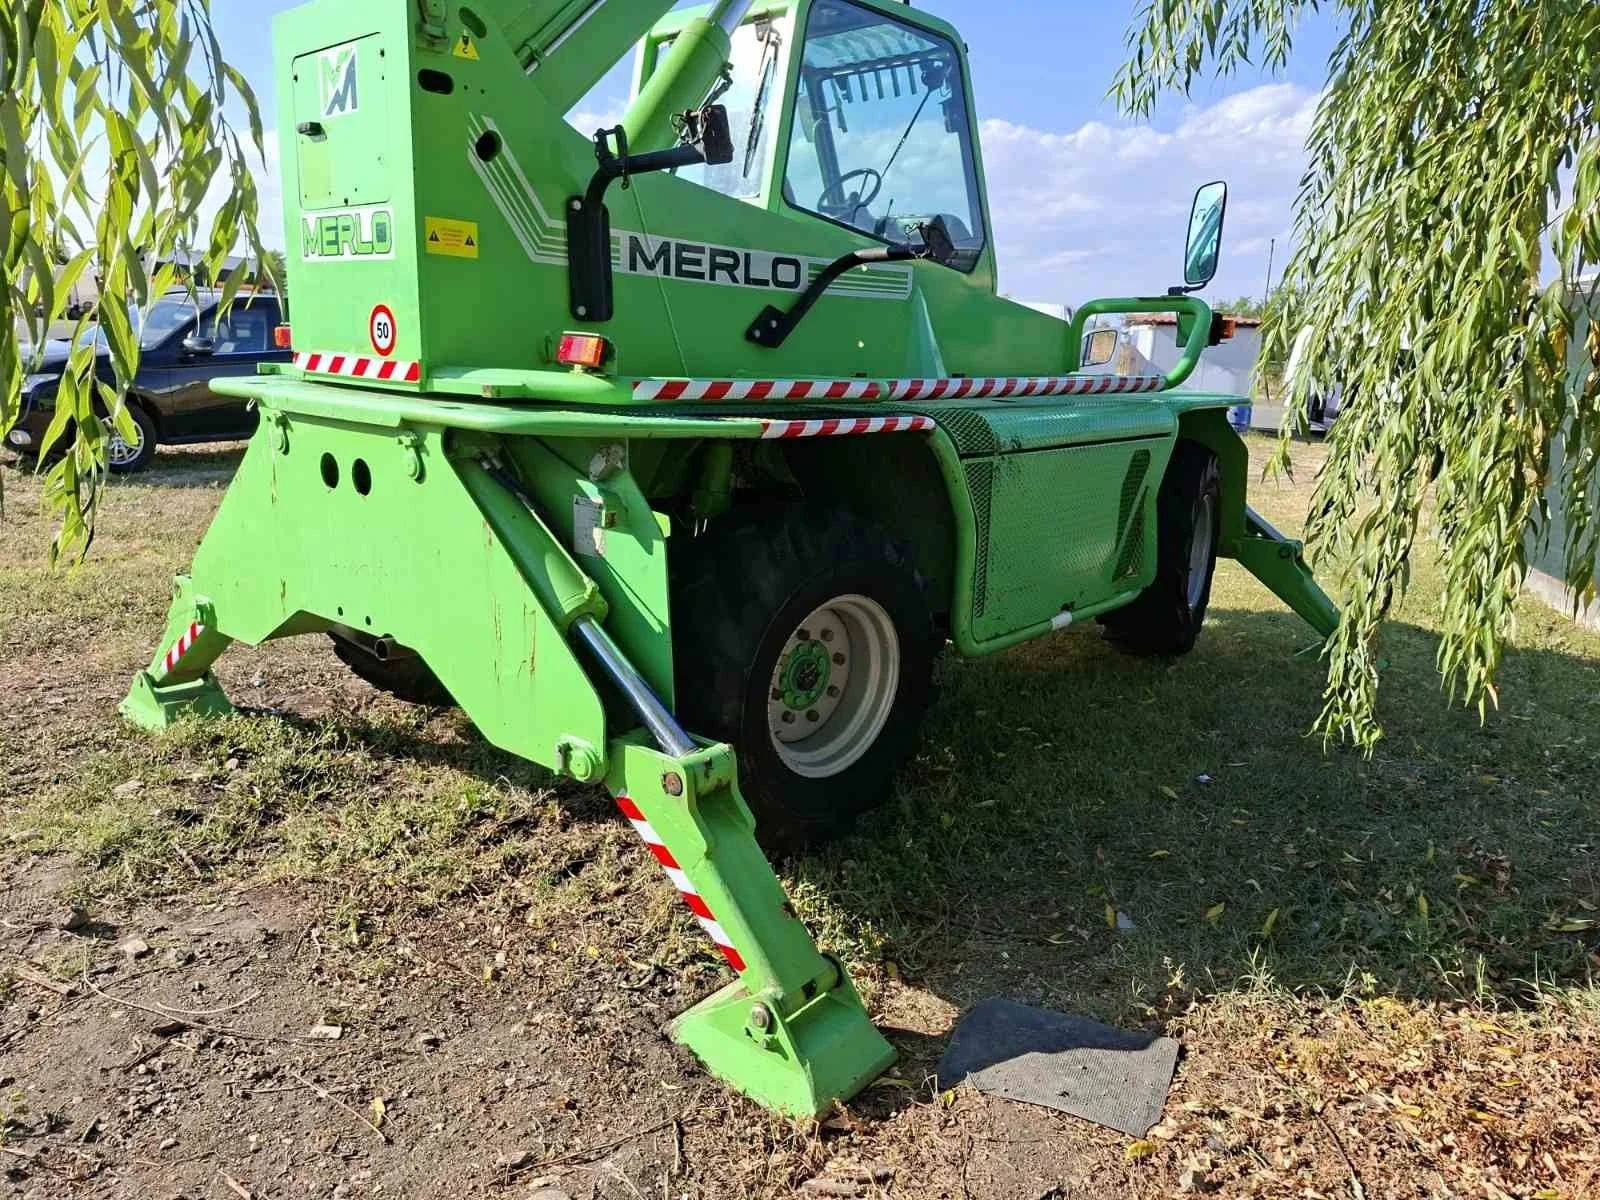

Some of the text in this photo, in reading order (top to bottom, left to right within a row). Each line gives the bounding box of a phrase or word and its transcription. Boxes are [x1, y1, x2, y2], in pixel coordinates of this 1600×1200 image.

[302, 211, 392, 258] MERLO
[628, 236, 801, 289] MERLO
[376, 321, 389, 339] 50
